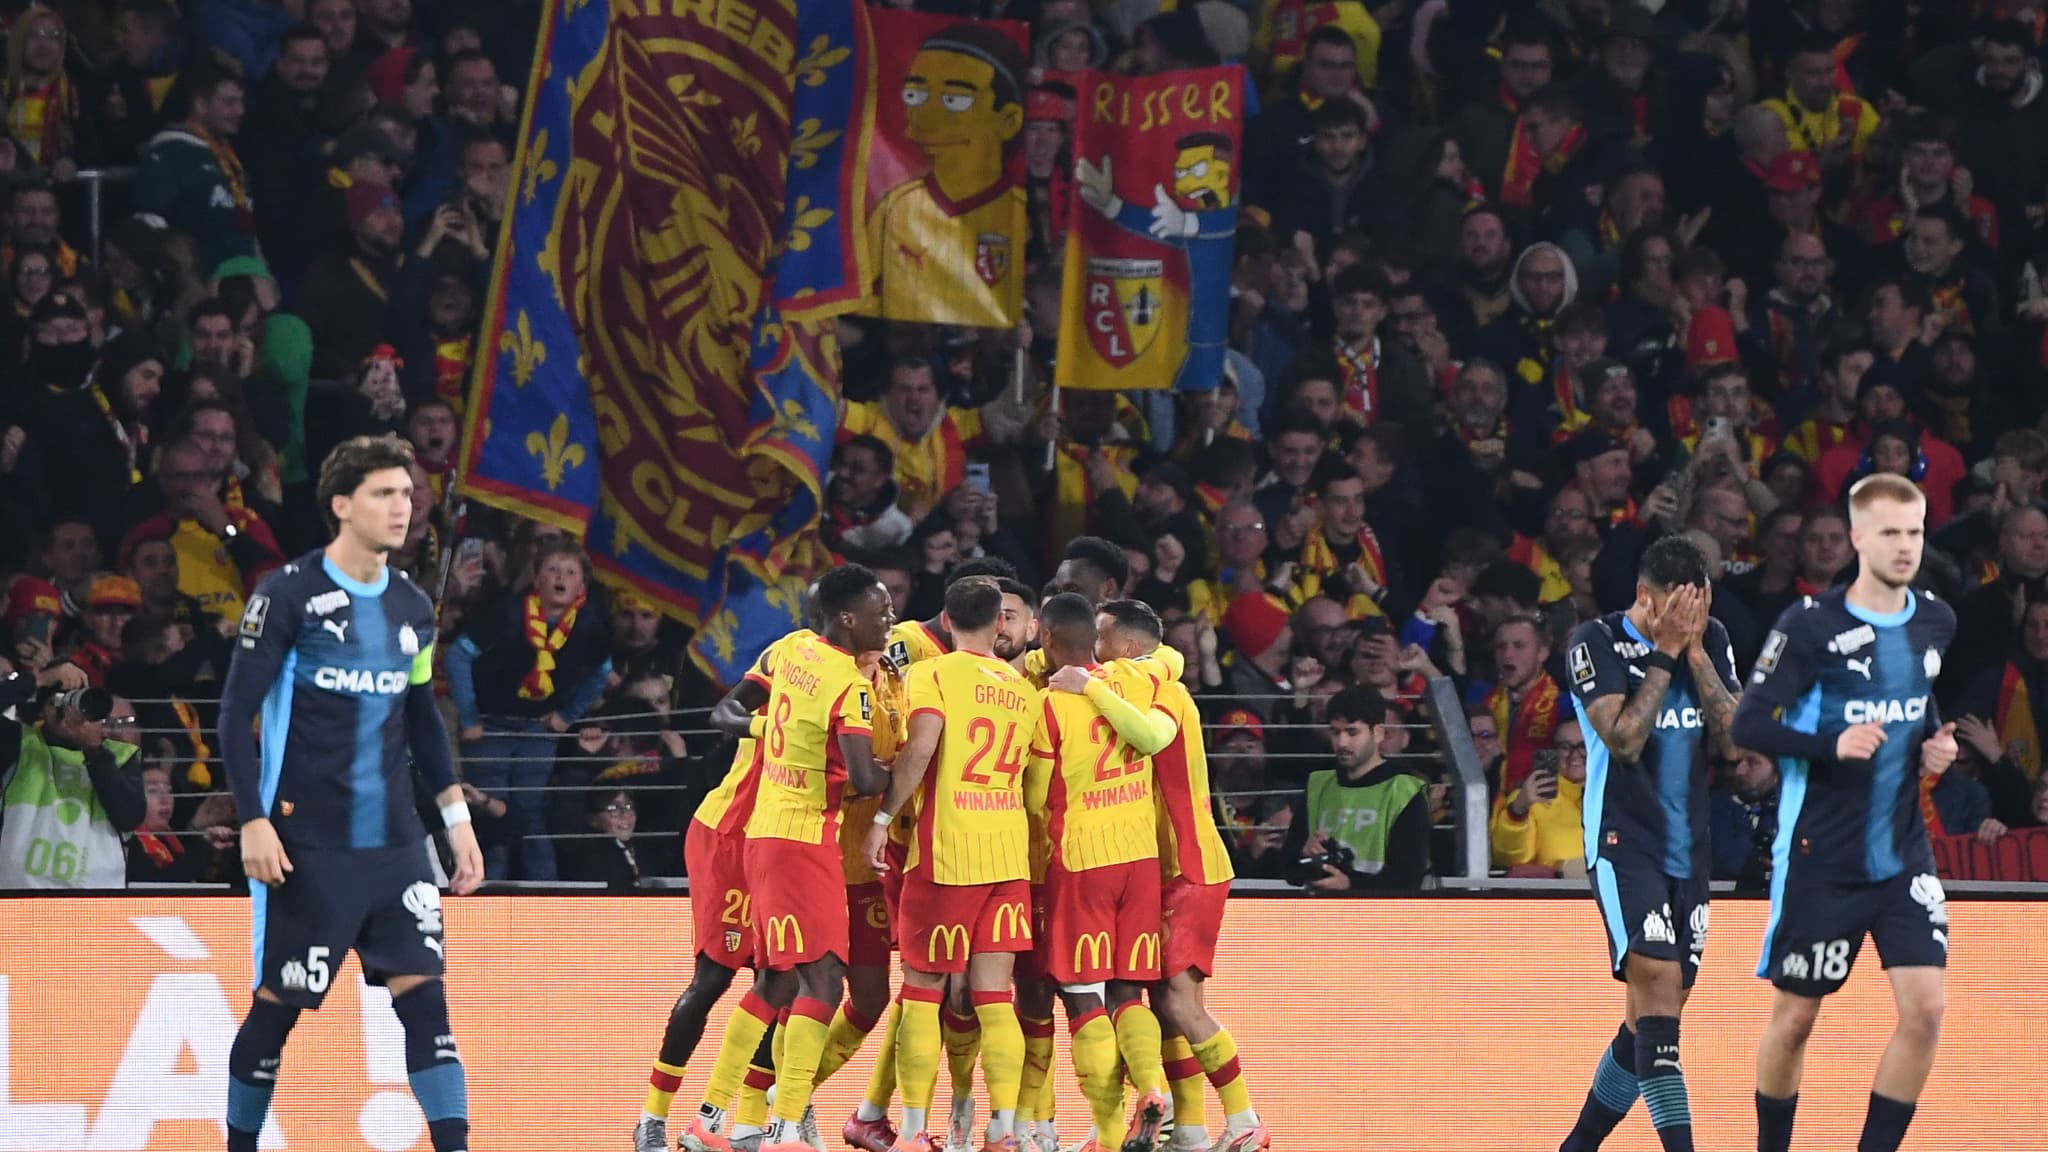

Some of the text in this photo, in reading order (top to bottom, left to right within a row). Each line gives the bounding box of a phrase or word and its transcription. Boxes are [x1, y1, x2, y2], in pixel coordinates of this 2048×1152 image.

[1091, 282, 1127, 356] RCL
[770, 692, 792, 759] 8
[961, 716, 1022, 789] 24
[1318, 808, 1378, 833] LFP
[24, 837, 78, 881] 06
[307, 946, 330, 993] 5
[1812, 939, 1850, 981] 18
